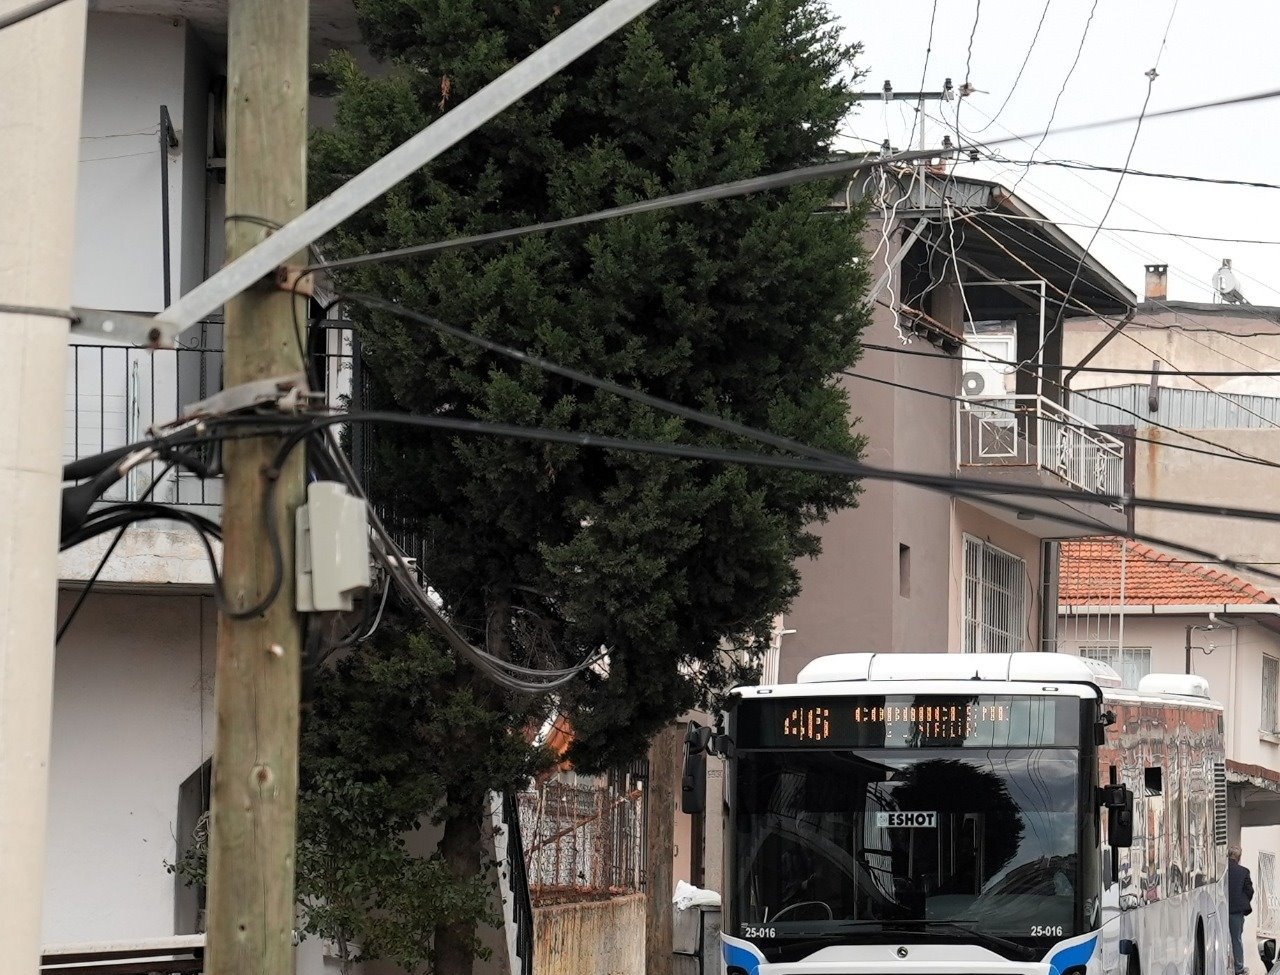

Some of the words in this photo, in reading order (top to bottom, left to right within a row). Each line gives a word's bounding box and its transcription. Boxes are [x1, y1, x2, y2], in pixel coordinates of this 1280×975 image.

[784, 707, 829, 741] 46
[888, 813, 934, 826] ESHOT
[745, 927, 776, 938] 25-016
[1030, 925, 1063, 937] 25-016
